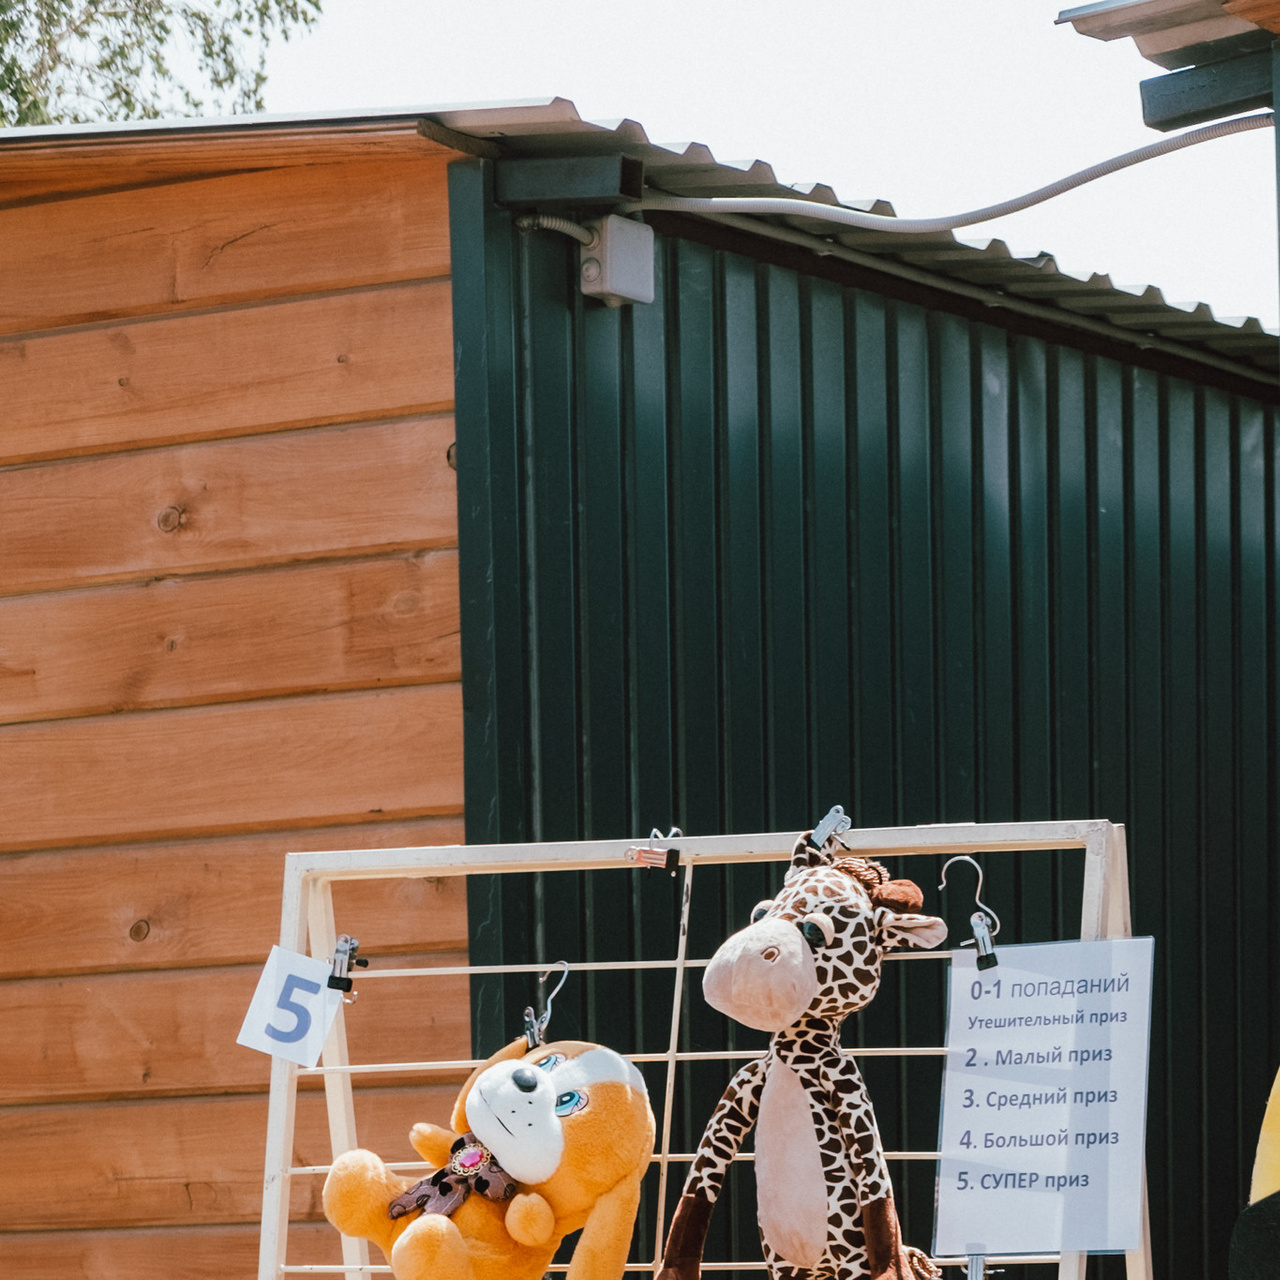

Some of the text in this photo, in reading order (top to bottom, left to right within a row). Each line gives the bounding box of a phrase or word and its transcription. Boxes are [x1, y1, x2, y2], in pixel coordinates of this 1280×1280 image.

[970, 973, 1130, 1000] 0-1 попаданий
[264, 972, 321, 1044] 5
[968, 1009, 1128, 1030] Утешительный приз
[995, 1046, 1063, 1066] Малый
[1068, 1047, 1113, 1066] приз
[962, 1087, 1118, 1111] 3. Средний приз
[959, 1129, 1120, 1150] 4. Большой приз
[956, 1170, 1090, 1191] 5. СУПЕР приз
